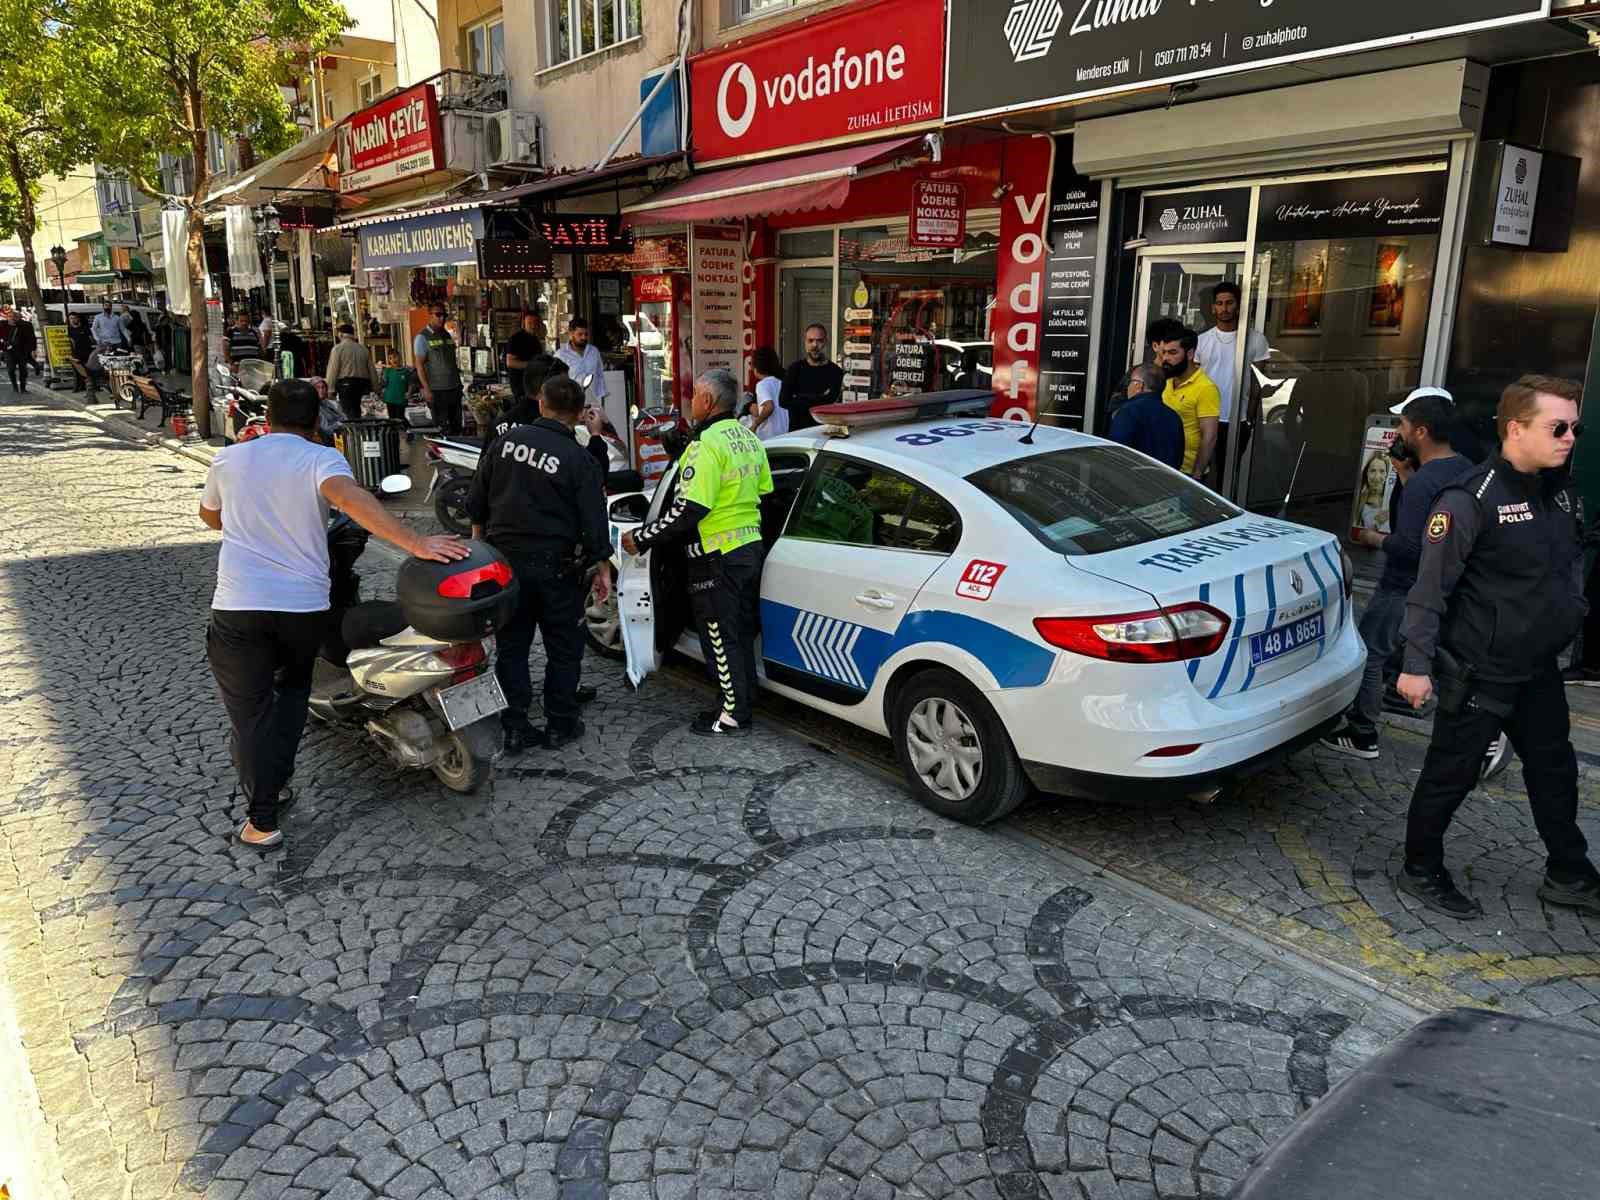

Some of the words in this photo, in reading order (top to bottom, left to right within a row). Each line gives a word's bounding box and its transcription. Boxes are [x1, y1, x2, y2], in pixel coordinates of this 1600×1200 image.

[1255, 24, 1307, 47] zuhalphoto
[1154, 49, 1174, 66] 0507
[1176, 47, 1187, 63] 711
[1188, 45, 1199, 60] 78
[1201, 42, 1211, 58] 54
[762, 44, 906, 109] vodafone
[1076, 65, 1112, 82] Menderes
[1113, 57, 1129, 75] EKİN
[847, 114, 882, 130] ZUHAL
[884, 100, 933, 122] İLETİŞİM
[352, 114, 388, 155] NARİN
[389, 97, 427, 148] ÇEYİZ
[920, 182, 960, 195] FATURA
[1066, 190, 1086, 200] DÜĞÜN
[921, 194, 957, 206] ÖDEME
[1504, 186, 1529, 206] ZUHAL
[917, 207, 960, 219] NOKTASI
[1182, 204, 1225, 219] ZUHAL
[1177, 219, 1229, 232] Fotoğrafçılık
[367, 226, 412, 257] KARANFİL
[412, 217, 474, 252] KURUYEMİŞ
[1063, 230, 1083, 240] DÜĞÜN
[699, 247, 737, 257] FATURA
[700, 259, 736, 270] ÖDEME
[697, 272, 738, 284] NOKTASI
[1051, 270, 1091, 280] PROFESYONEL
[895, 344, 924, 355] FATURA
[896, 357, 922, 368] ÖDEME
[892, 370, 925, 382] MERKEZİ
[495, 422, 523, 436] TRA
[896, 421, 1031, 446] 8657
[501, 441, 561, 475] POLİS
[1138, 535, 1249, 573] TRAFİK
[967, 563, 998, 584] 112
[1264, 631, 1281, 655] 48
[1285, 628, 1294, 649] A
[1296, 620, 1322, 643] 8657
